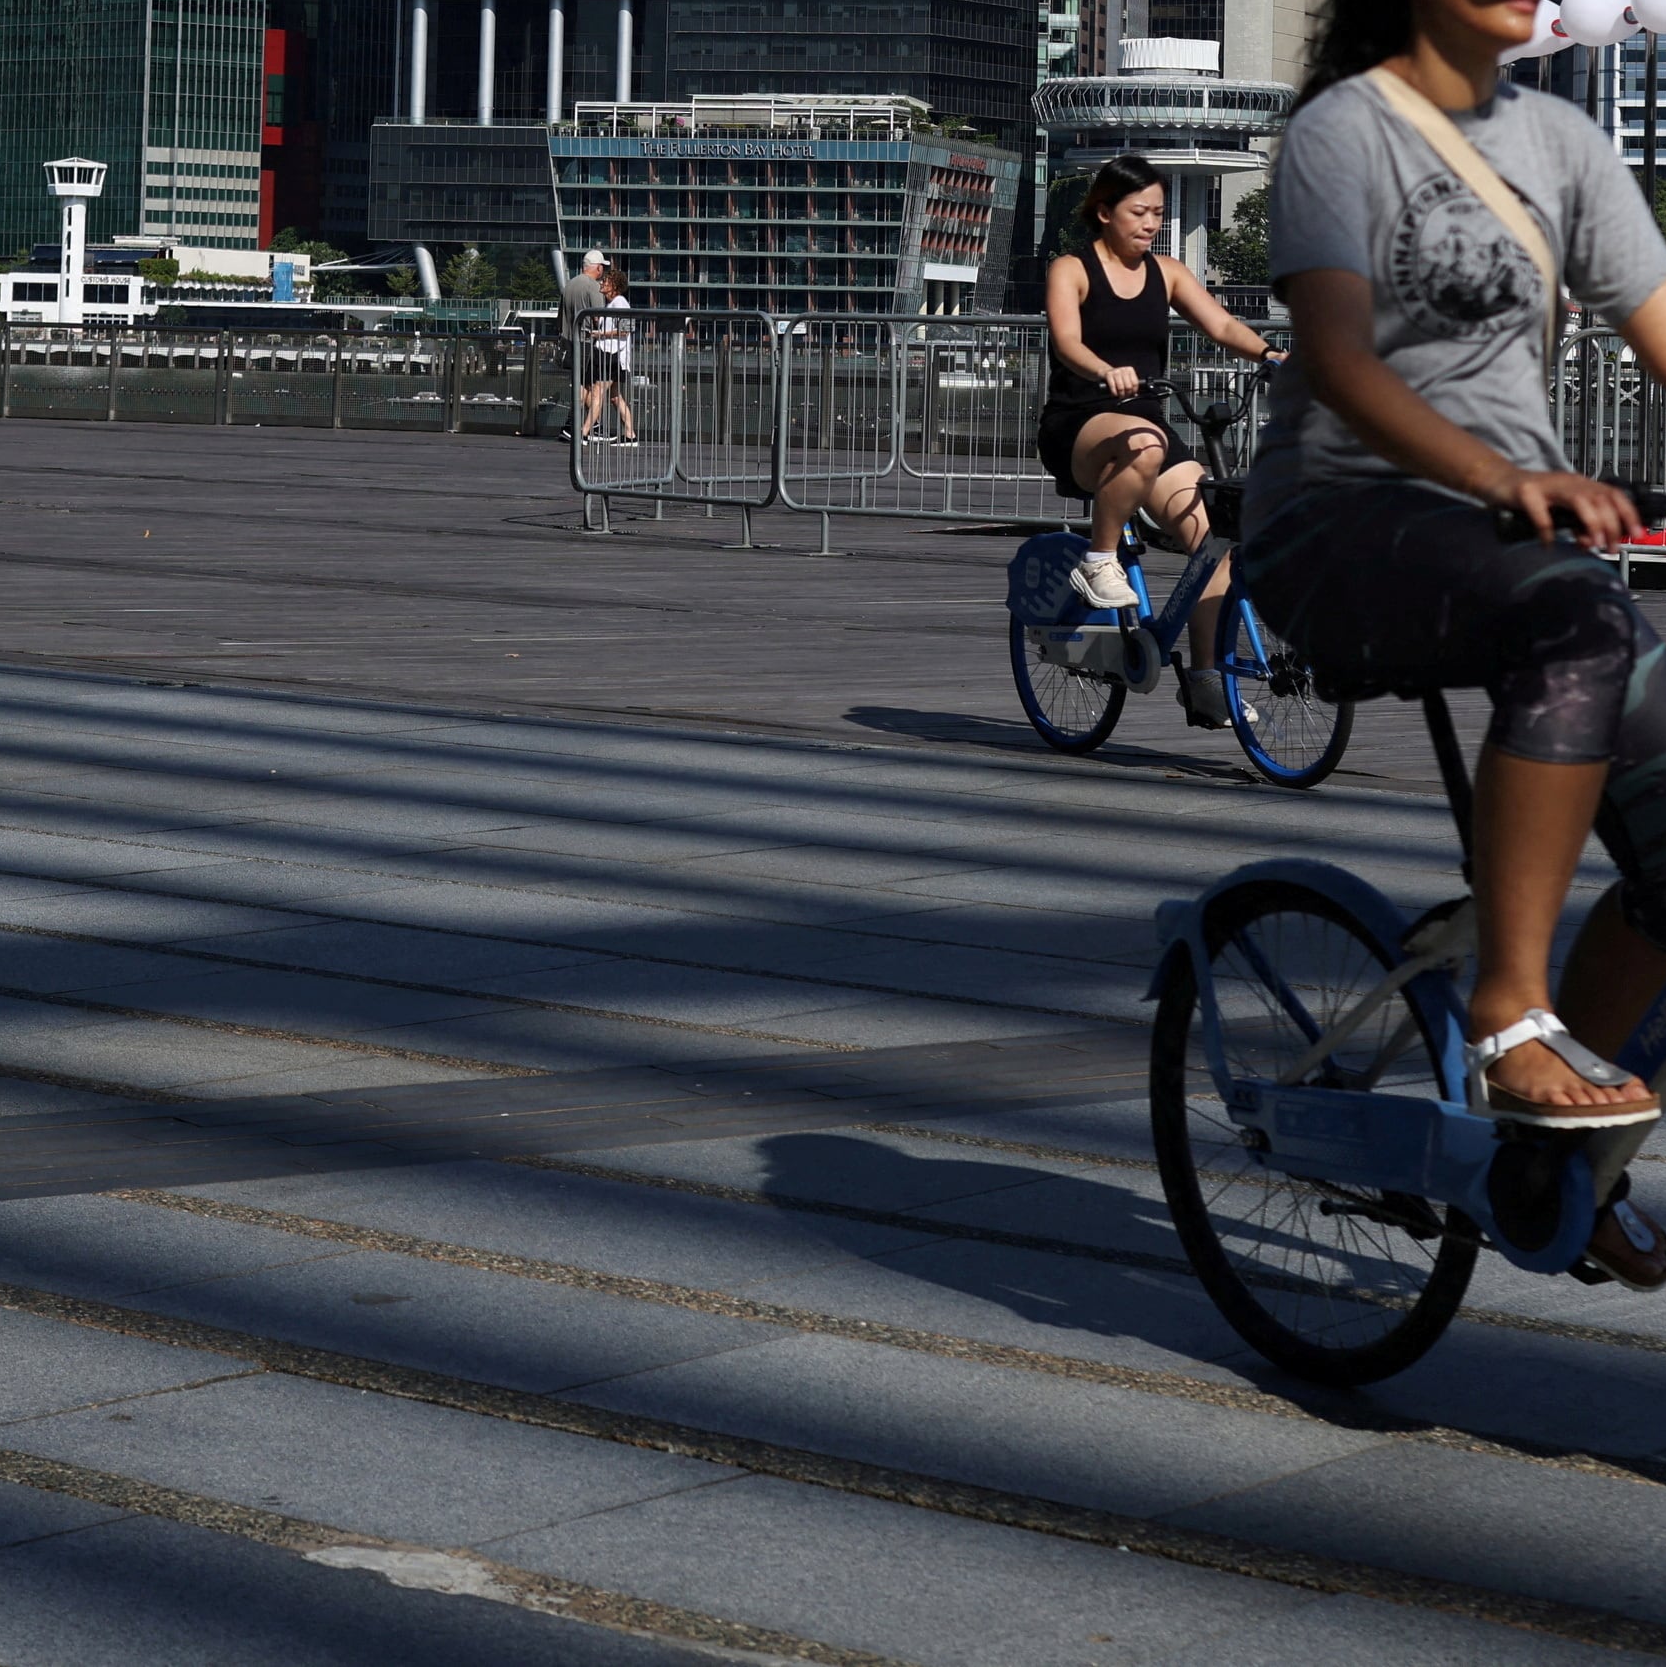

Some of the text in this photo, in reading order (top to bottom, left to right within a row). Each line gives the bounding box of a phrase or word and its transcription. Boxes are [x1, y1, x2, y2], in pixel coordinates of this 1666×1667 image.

[641, 142, 816, 157] THE FULLERTON BAY HOTEL
